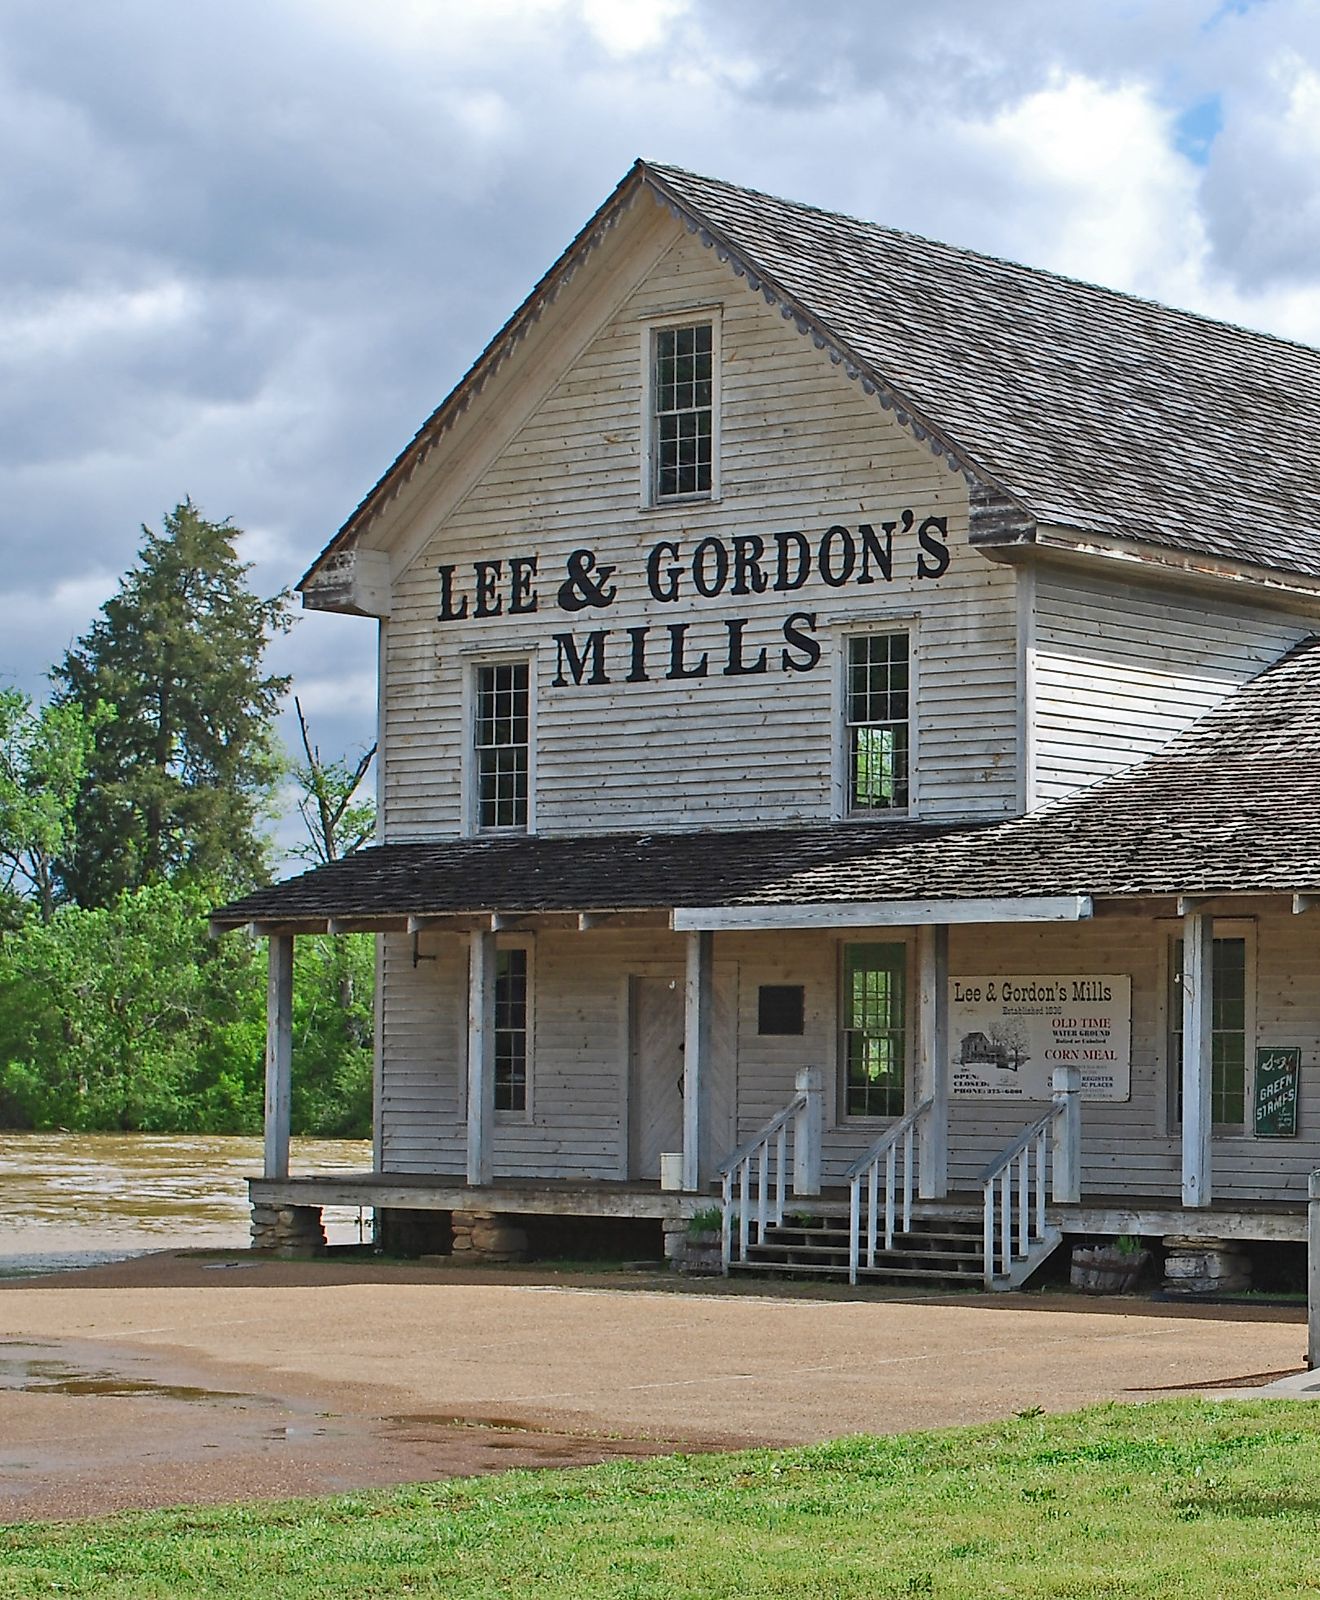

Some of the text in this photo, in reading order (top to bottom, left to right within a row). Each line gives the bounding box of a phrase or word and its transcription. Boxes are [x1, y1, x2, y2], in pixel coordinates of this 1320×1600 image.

[437, 509, 951, 622] LEE & GORDON'S
[551, 612, 822, 687] MILLS
[954, 981, 1112, 1001] Lee & Gordon's Mills
[1052, 1018, 1111, 1028] OLD TIME
[1044, 1049, 1117, 1060] CORN MEAL
[1260, 1073, 1293, 1101] GREEN
[1256, 1088, 1295, 1120] STAMPS
